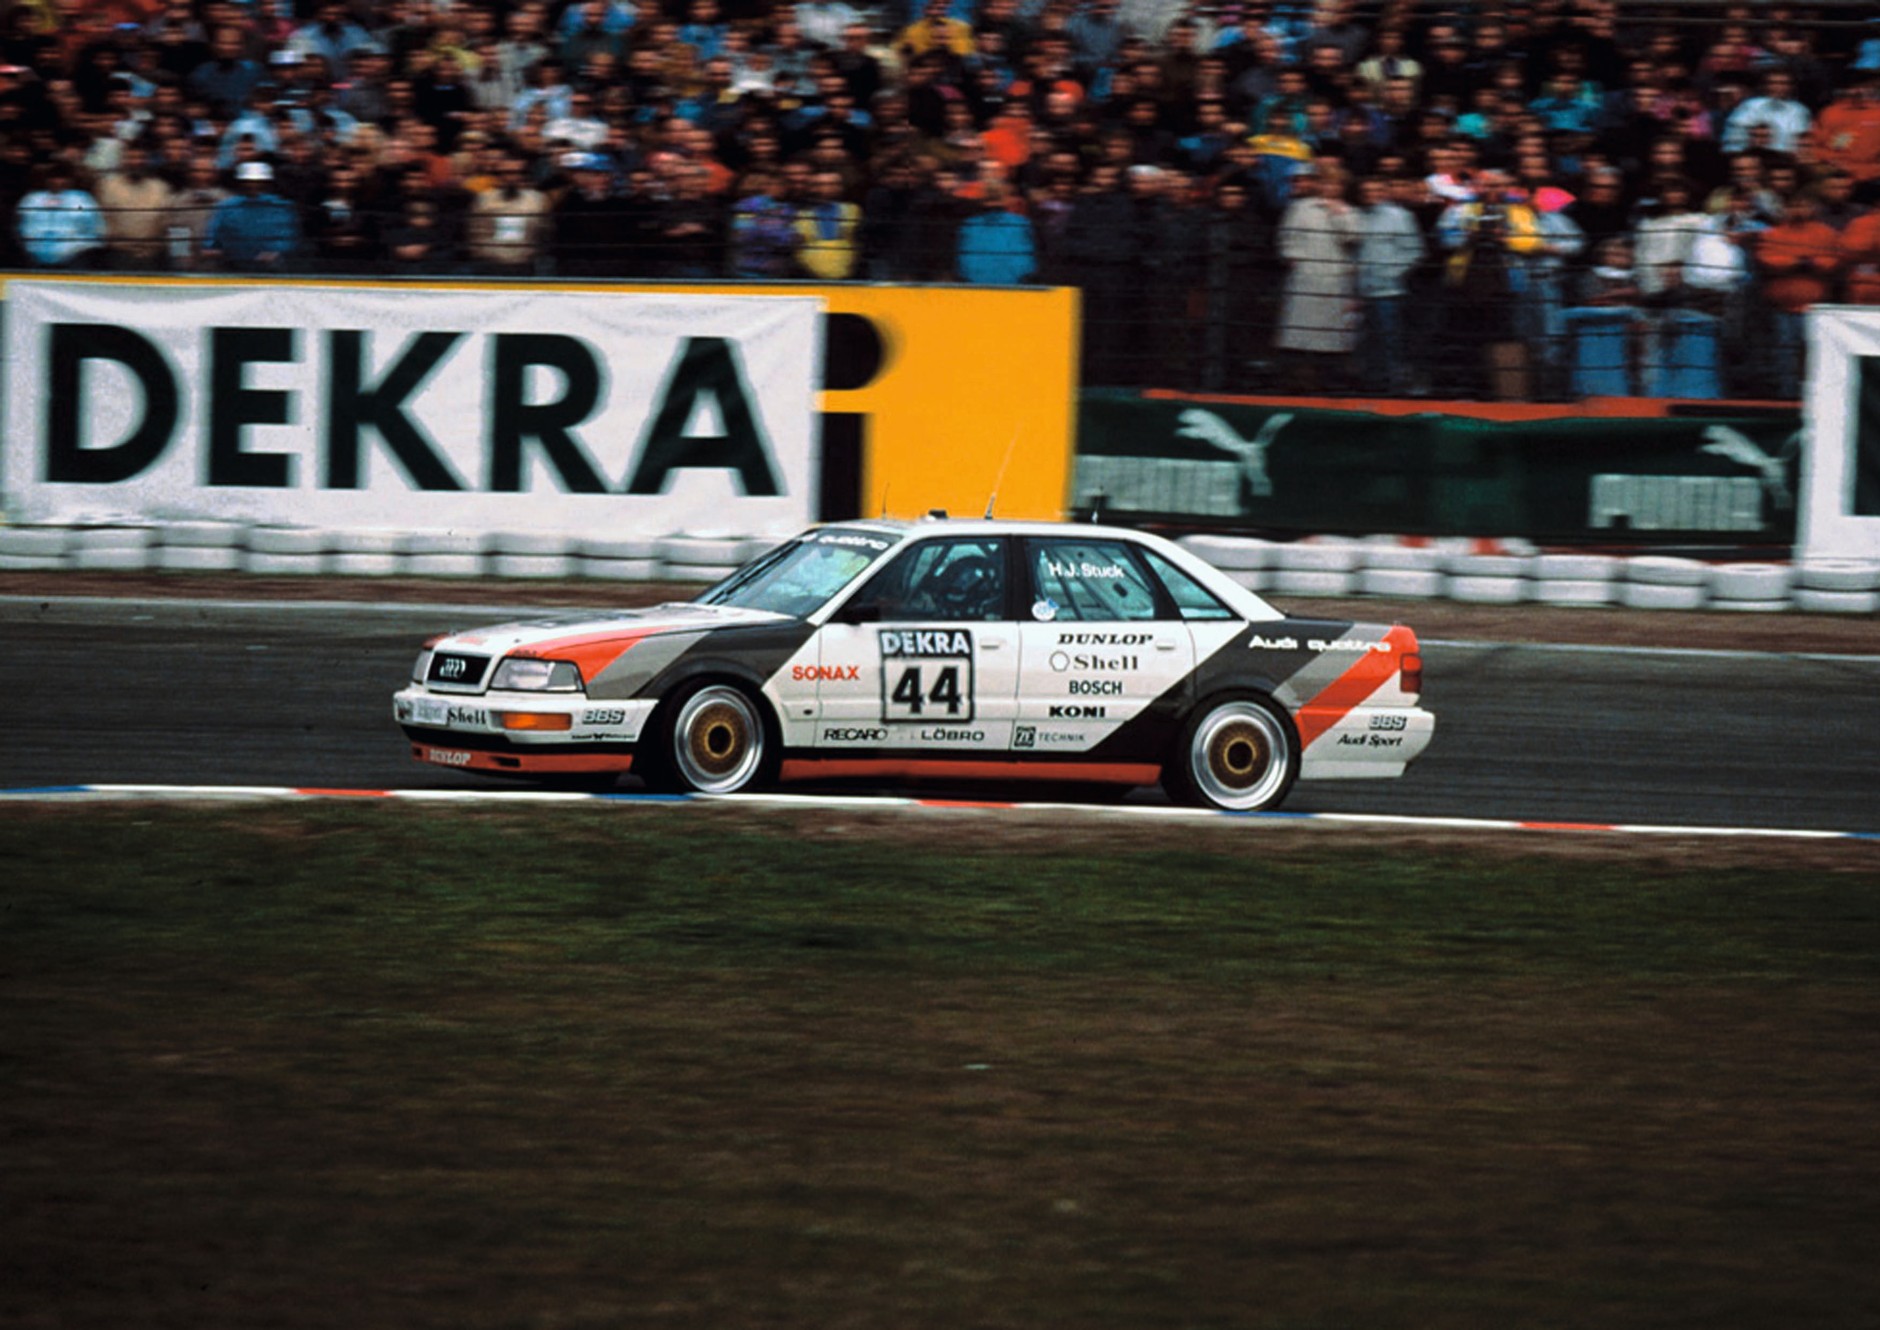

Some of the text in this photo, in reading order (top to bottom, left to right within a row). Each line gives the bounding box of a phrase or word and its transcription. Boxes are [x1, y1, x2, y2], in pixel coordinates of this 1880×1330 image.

[43, 322, 787, 496] DEKRA
[1081, 562, 1125, 579] Stuck
[882, 632, 969, 654] DEKRA
[1057, 633, 1154, 646] DUNLOP
[1249, 635, 1391, 652] Audi quattro
[1073, 654, 1138, 670] Shell
[792, 665, 860, 681] SONAX
[891, 666, 963, 715] 44
[1069, 680, 1123, 695] BOSCH
[447, 707, 487, 725] Shell
[1049, 705, 1106, 718] KONI
[823, 728, 888, 742] RECARO
[921, 727, 985, 742] LÖBRO
[1337, 733, 1403, 748] Audi Sport
